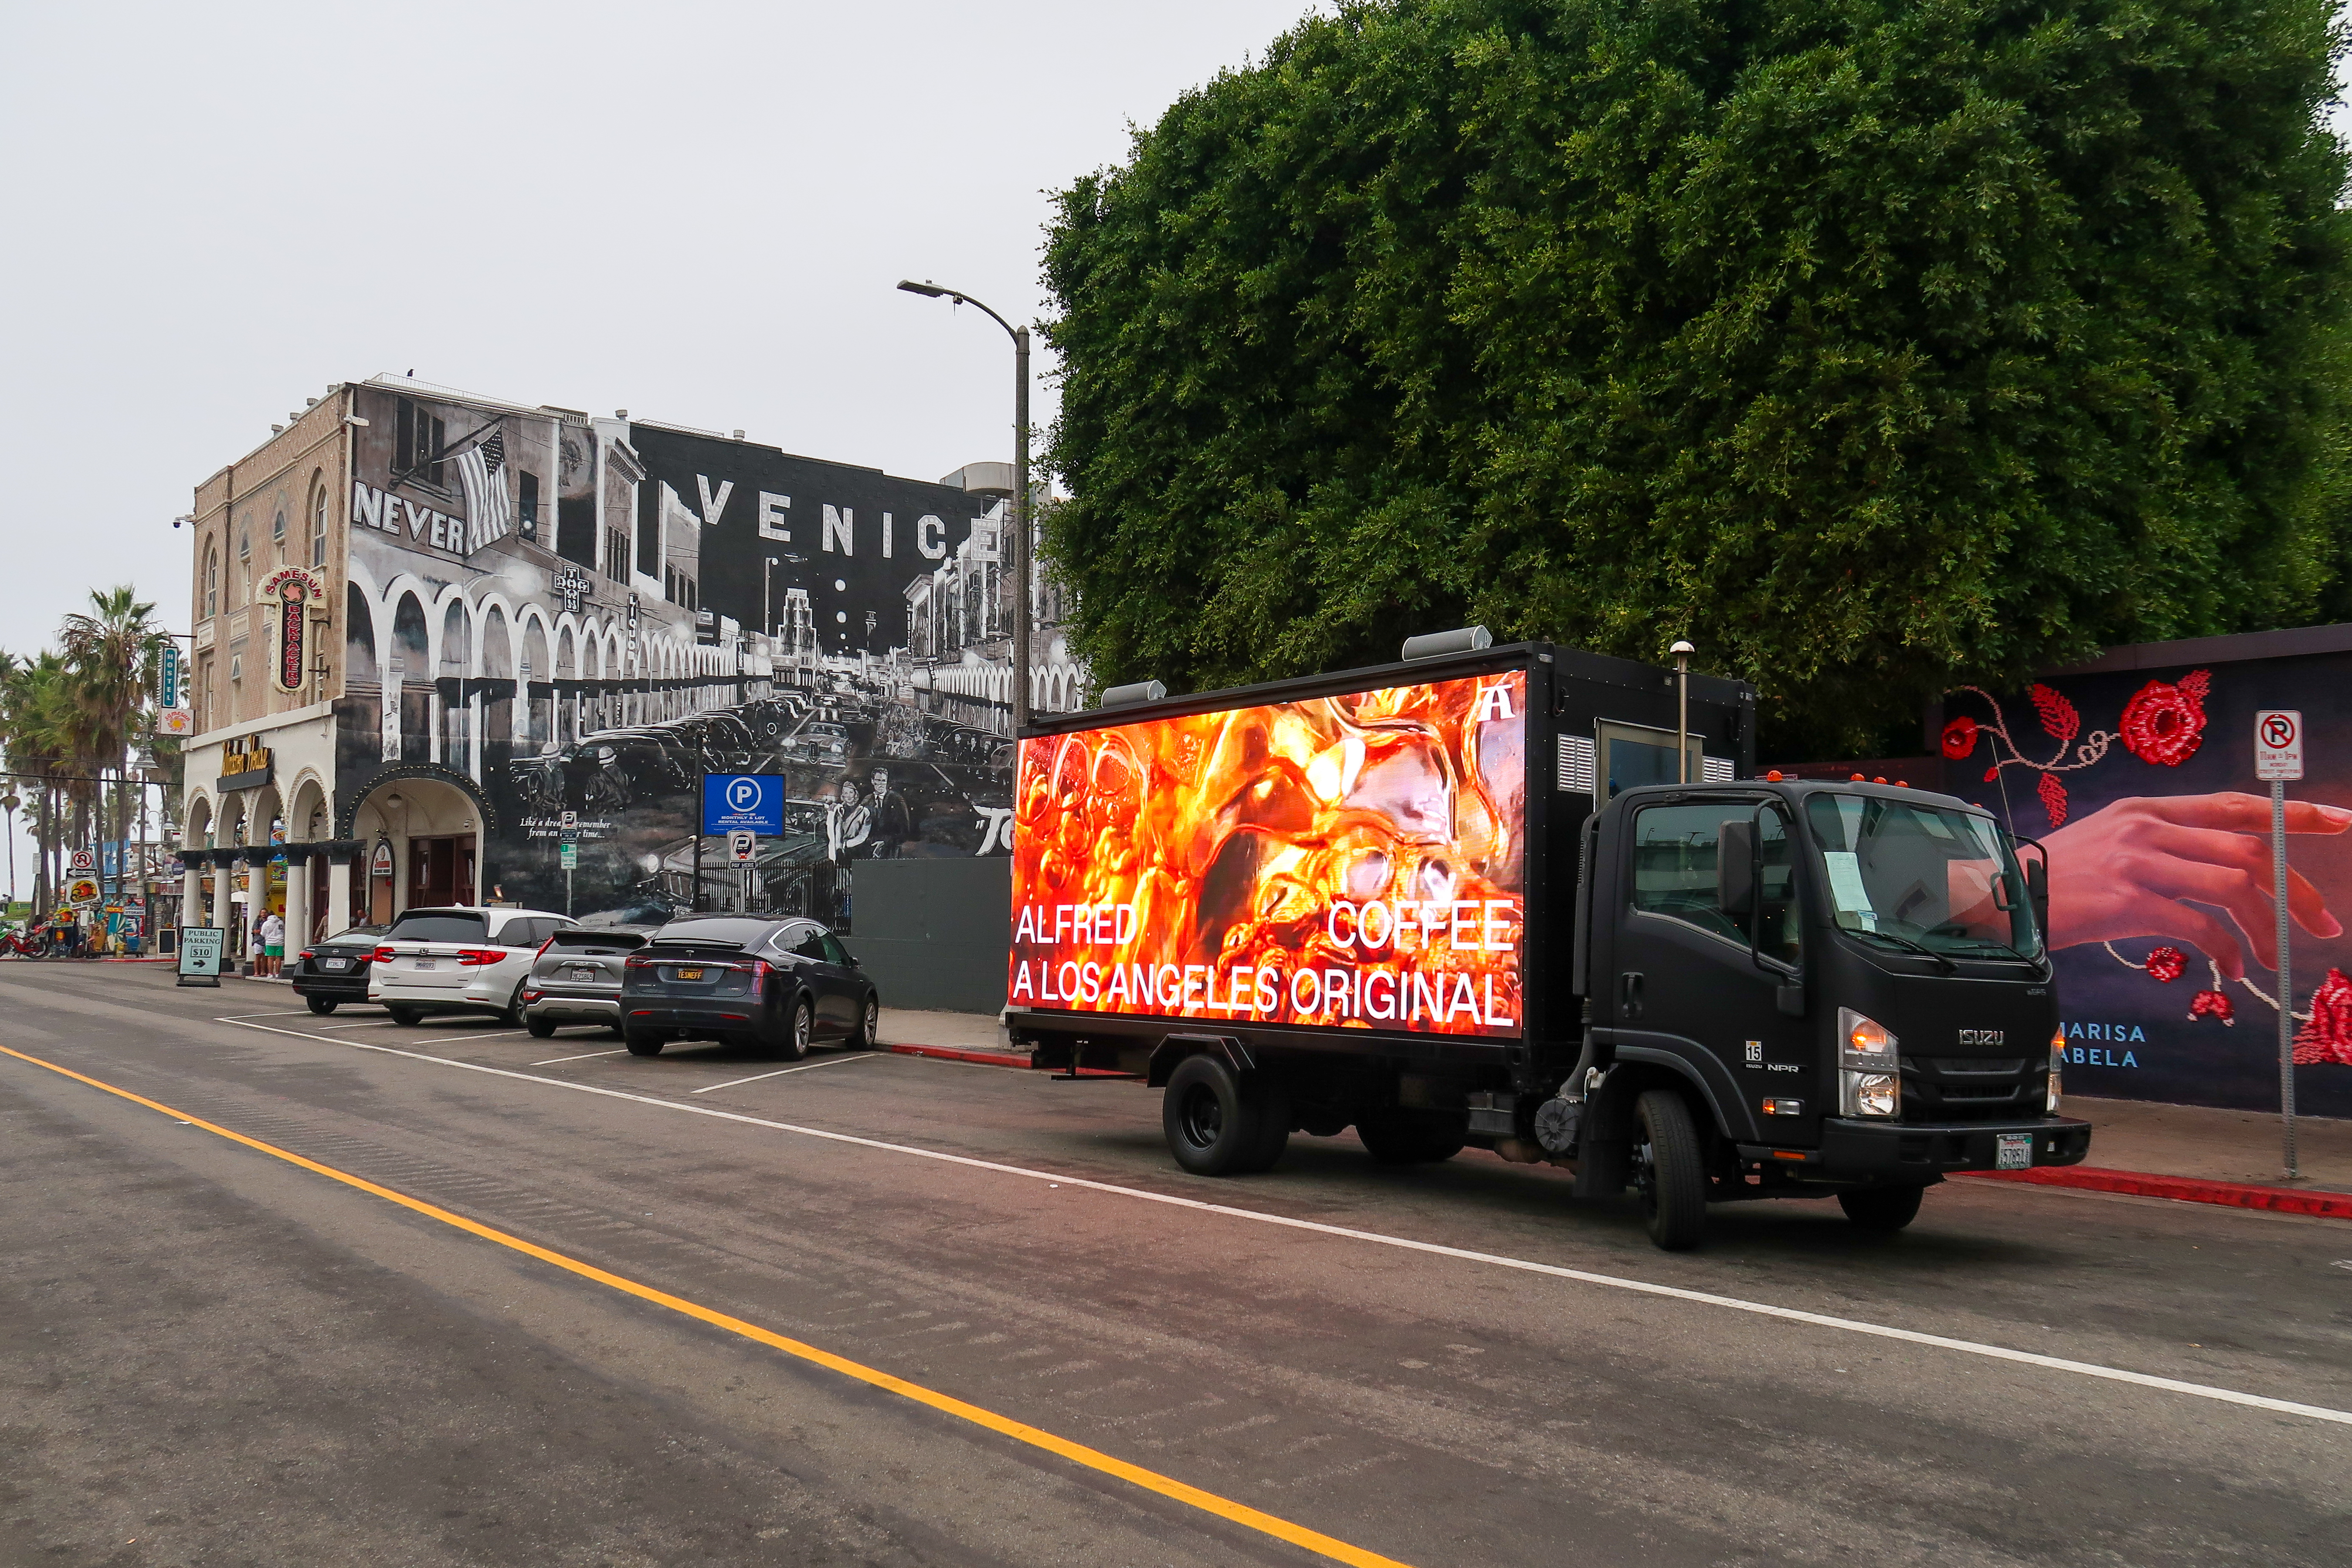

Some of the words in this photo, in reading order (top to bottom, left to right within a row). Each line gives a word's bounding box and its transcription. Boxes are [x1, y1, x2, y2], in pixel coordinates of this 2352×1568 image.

[353, 481, 463, 554] NEVER
[696, 473, 998, 562] VENICE
[265, 570, 322, 599] SAMESUN
[286, 605, 301, 687] BACKPACKERS
[737, 786, 752, 803] P
[519, 816, 536, 826] Like
[545, 817, 562, 827] drea
[576, 819, 611, 828] remember
[526, 827, 546, 840] from
[1015, 903, 1137, 944] ALFRED
[1328, 899, 1514, 950] COFFEE
[677, 971, 702, 979] TESNEFF
[1013, 960, 1034, 999] A
[1041, 960, 1100, 1002] LOS
[1107, 963, 1279, 1012] ANGELES
[1290, 967, 1514, 1026] ORIGINAL
[1959, 1029, 2004, 1045] ISUZU
[1747, 1046, 1761, 1060] 15
[1767, 1064, 1799, 1073] NPR
